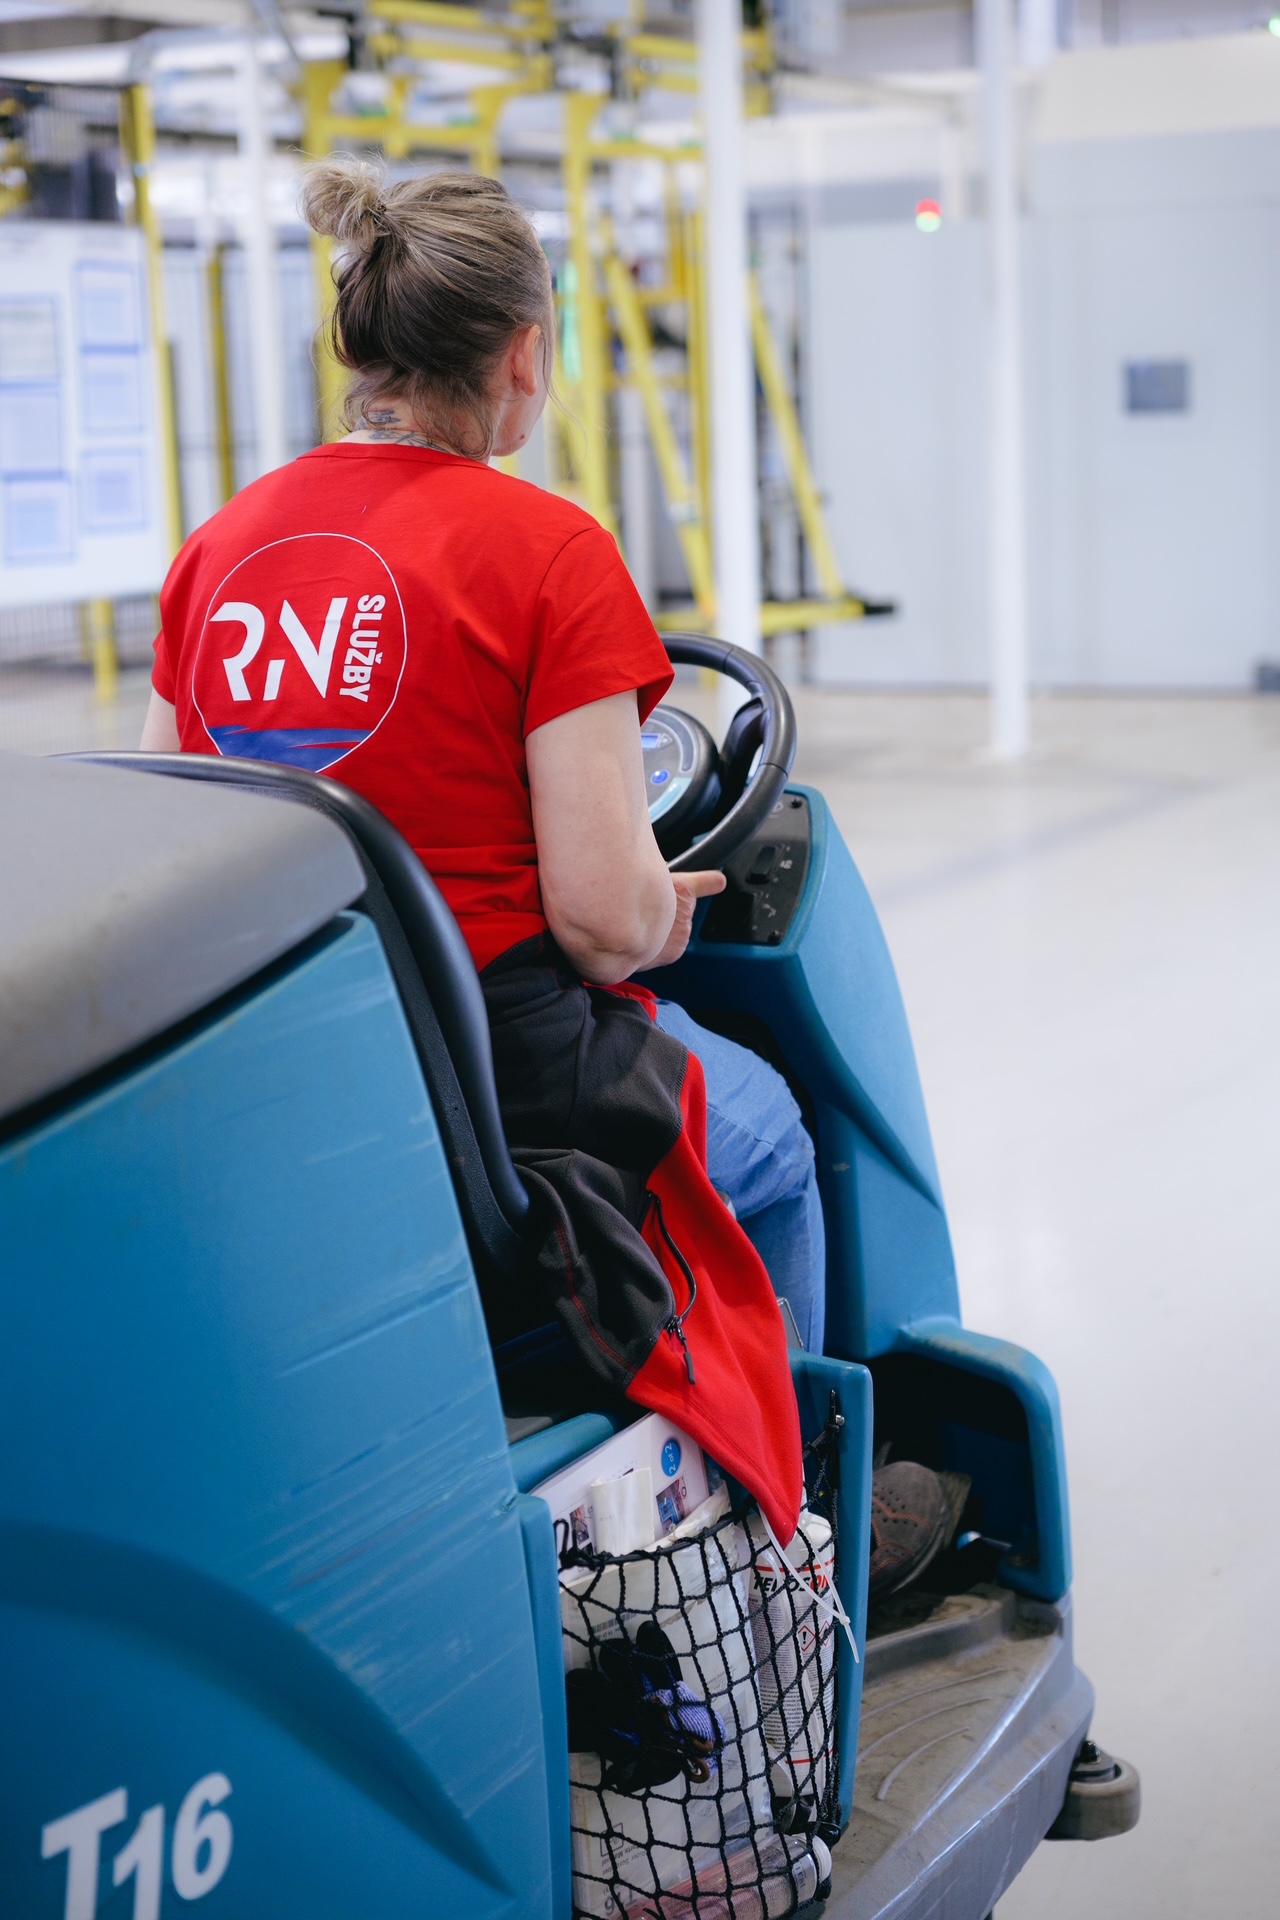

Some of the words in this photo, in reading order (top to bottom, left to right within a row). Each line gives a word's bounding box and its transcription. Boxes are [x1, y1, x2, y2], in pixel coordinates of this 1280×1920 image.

[339, 594, 386, 703] SLUŽBY
[664, 1443, 672, 1453] 2
[668, 1464, 676, 1474] 2
[41, 1771, 233, 1920] T16
